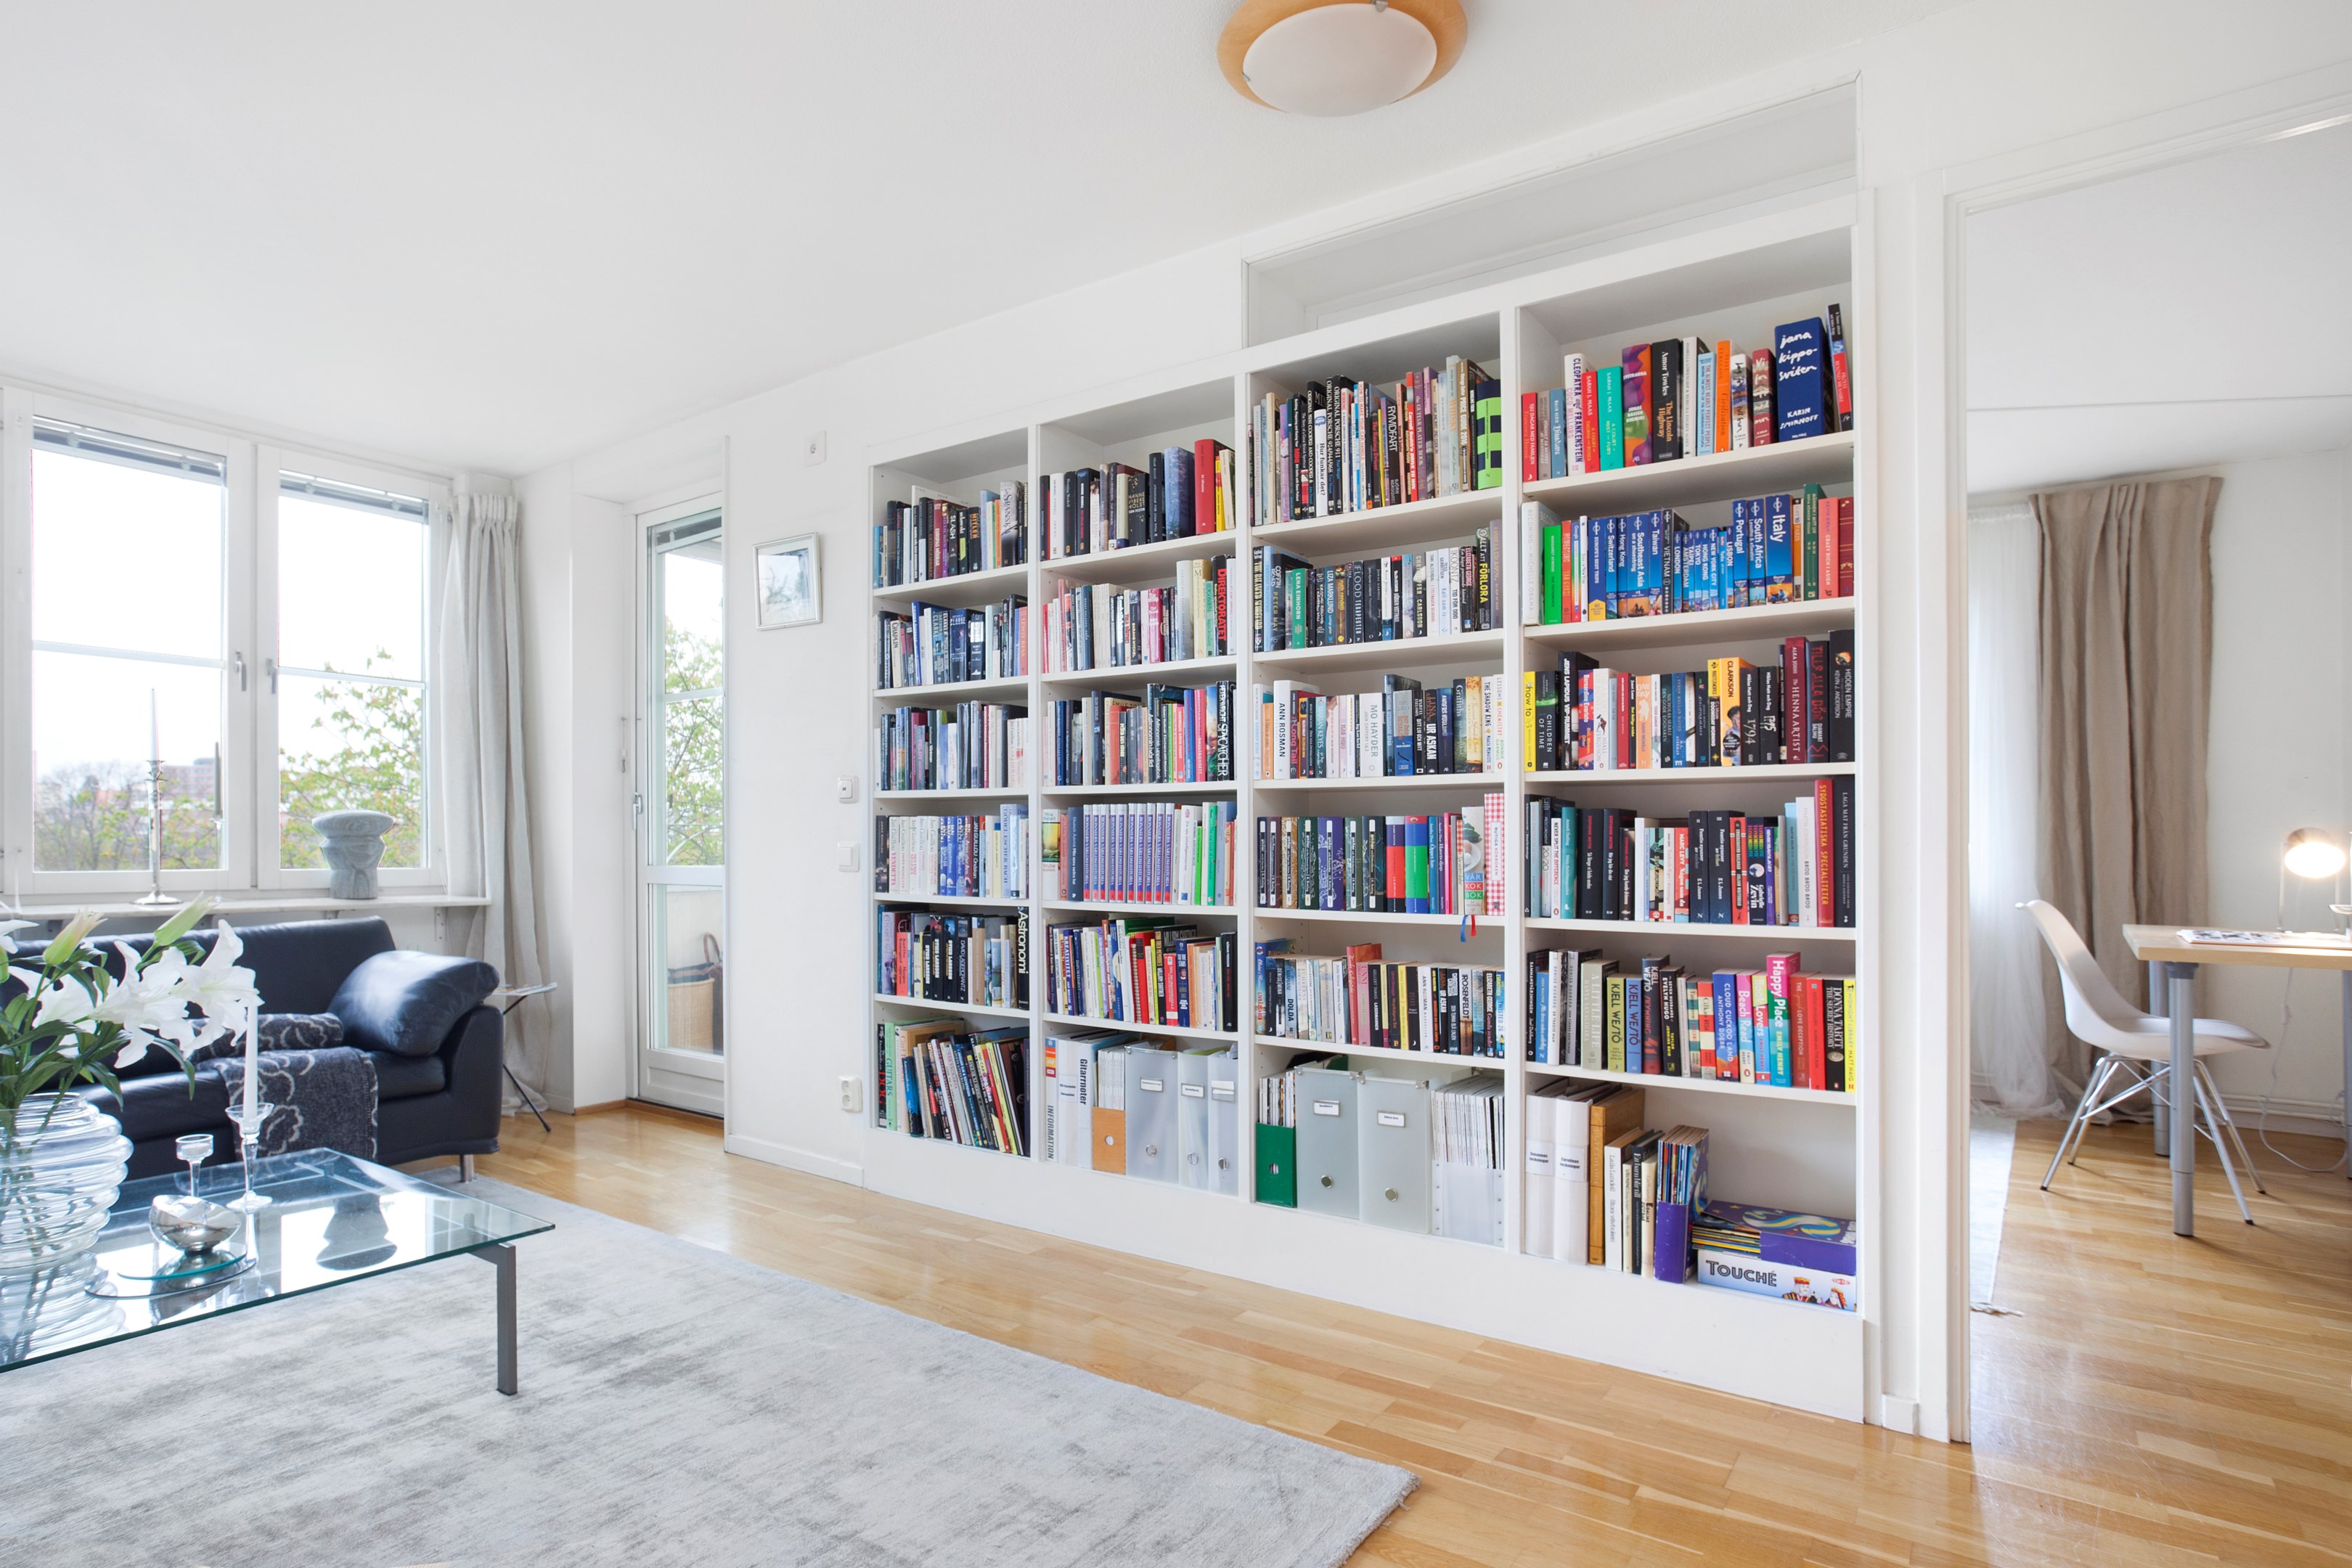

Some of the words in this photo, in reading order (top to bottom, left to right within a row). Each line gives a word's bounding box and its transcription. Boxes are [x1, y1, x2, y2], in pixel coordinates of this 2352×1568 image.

[1780, 330, 1812, 349] jana
[1779, 364, 1818, 383] sviten
[1573, 399, 1582, 409] and
[1787, 407, 1811, 419] KARIN
[1387, 406, 1397, 452] RYMDFART
[1657, 408, 1665, 438] Highway
[1734, 520, 1744, 553] Portugal
[1754, 518, 1763, 543] South
[1770, 515, 1786, 542] Italy
[1479, 563, 1490, 603] FÖRLORA
[1217, 568, 1227, 641] DIREKTORATET
[1371, 706, 1377, 719] MO
[1426, 724, 1436, 734] UR
[1218, 724, 1228, 776] SPYCATCHER
[1427, 735, 1437, 759] ASKAN
[1465, 891, 1482, 900] BOK
[1018, 911, 1029, 973] Astronomi
[1755, 979, 1765, 1003] Book
[1771, 960, 1784, 997] Happy
[1739, 990, 1749, 1017] Beach
[1774, 999, 1786, 1027] Place
[1833, 987, 1842, 1018] DONNA
[1739, 1019, 1752, 1042] Read
[1756, 1005, 1765, 1037] Lovers
[1834, 1019, 1843, 1049] TARTT
[1706, 1260, 1777, 1286] TOUCHÉ
